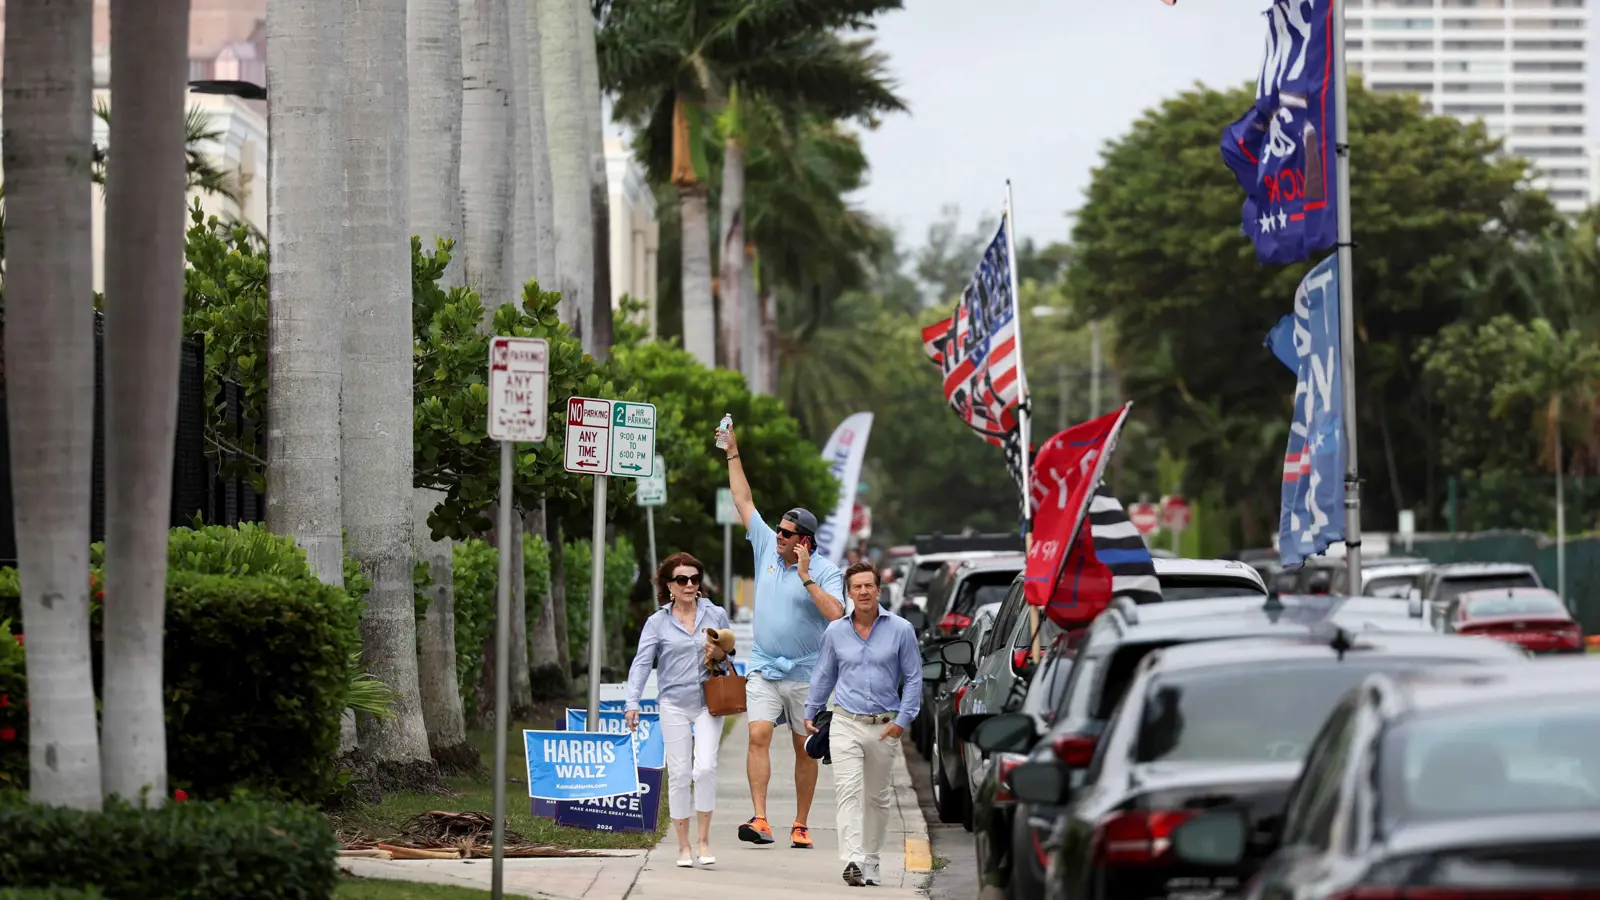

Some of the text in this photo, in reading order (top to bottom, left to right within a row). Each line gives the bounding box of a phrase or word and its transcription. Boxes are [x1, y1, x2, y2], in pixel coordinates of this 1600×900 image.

[506, 375, 532, 388] ANY
[504, 389, 533, 407] TIME
[570, 402, 609, 423] NO PARKING
[616, 406, 625, 423] 2
[635, 408, 645, 417] HR
[627, 416, 652, 426] PARKING
[578, 430, 598, 443] ANY
[619, 432, 647, 442] 9:00 AM
[577, 445, 597, 458] TIME
[629, 441, 637, 450] TO
[619, 451, 646, 460] 6:00 PM
[543, 738, 616, 764] HARRIS
[555, 764, 607, 779] WALZ
[578, 794, 640, 812] VANCE
[584, 806, 608, 815] AMERICA
